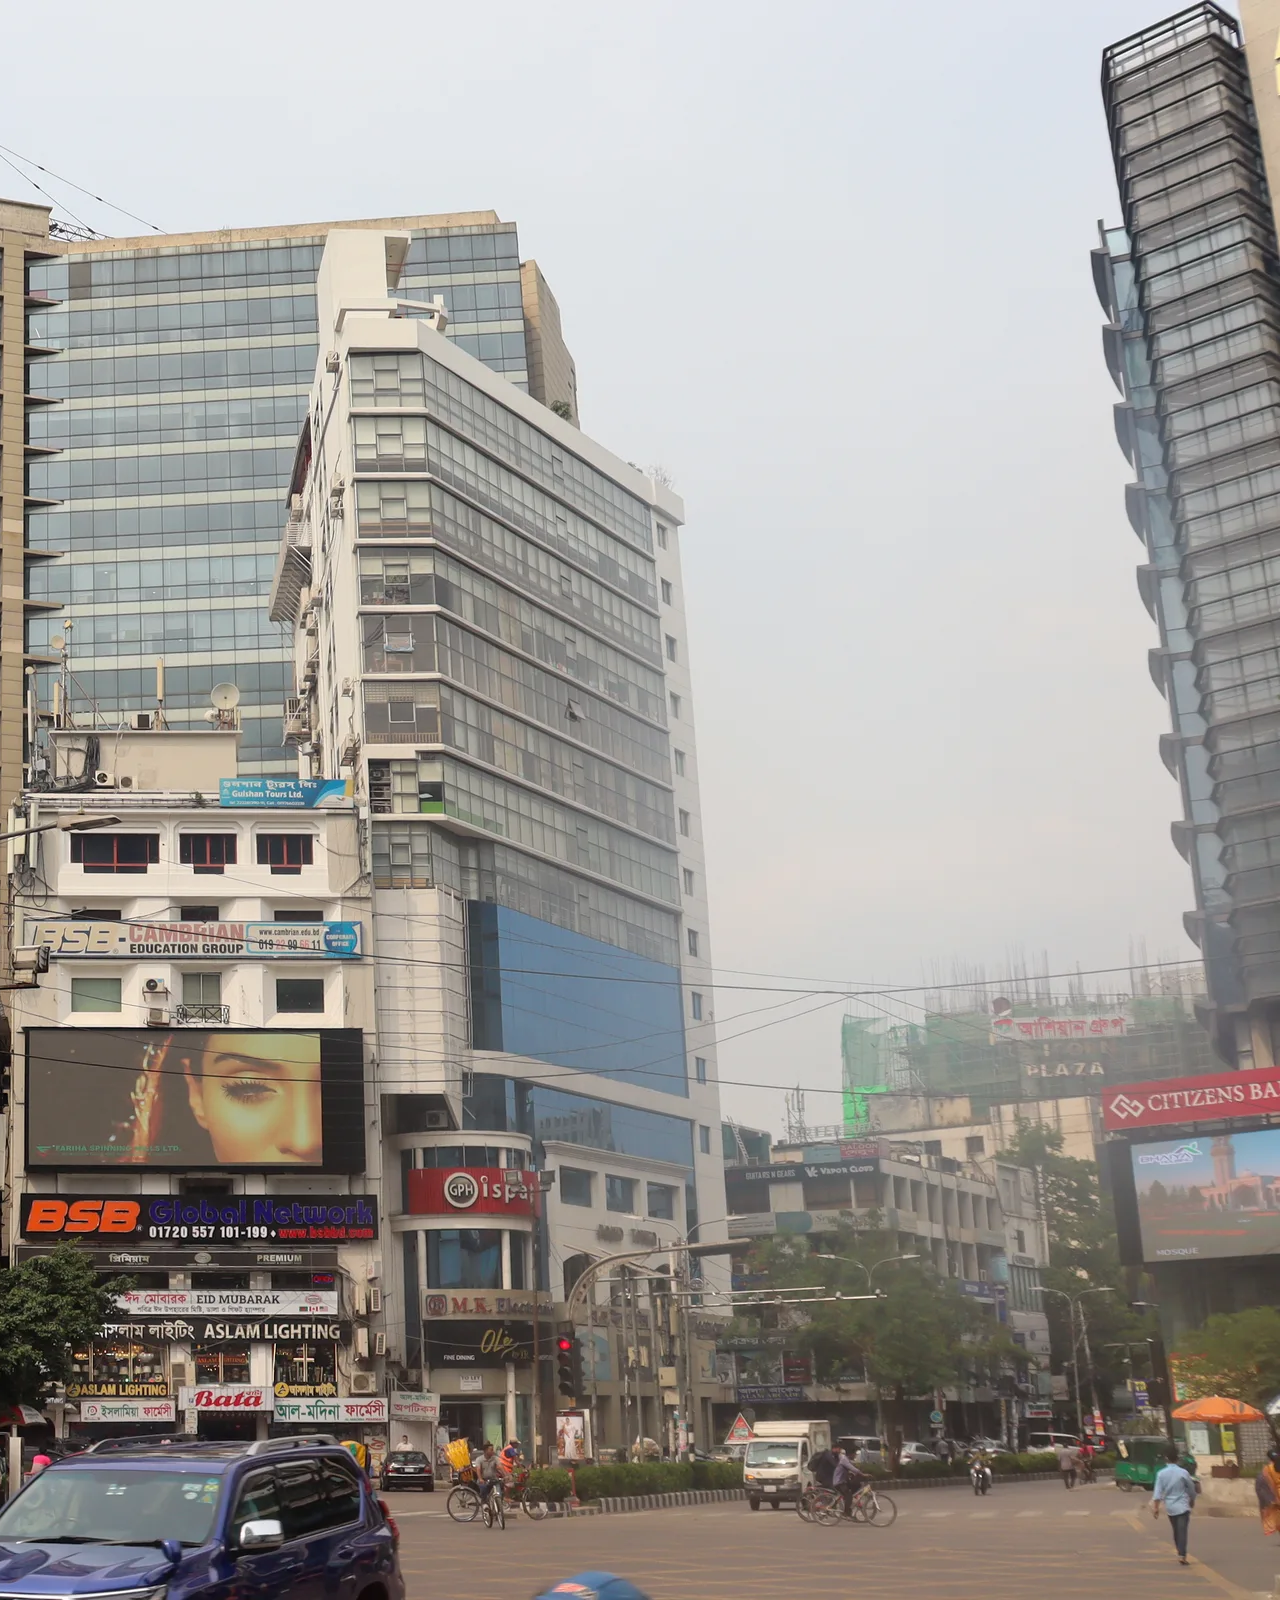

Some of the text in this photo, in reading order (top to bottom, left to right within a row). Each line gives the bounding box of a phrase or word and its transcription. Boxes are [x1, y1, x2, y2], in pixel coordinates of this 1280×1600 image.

[232, 790, 304, 798] Gulshan Tours Ltd.
[128, 923, 244, 943] CAMBRIAN
[258, 928, 320, 936] www.cambrian.edu.bd
[130, 943, 244, 954] EDUCATION GROUP
[1026, 1061, 1105, 1077] PLAZA
[1148, 1080, 1280, 1111] CITIZENS BA
[776, 1169, 796, 1178] GEARS
[449, 1183, 474, 1197] GPH
[26, 1199, 374, 1233] BSB Global Network
[149, 1226, 374, 1239] 01720 557 101-199 www.bsbbd.com
[256, 1254, 302, 1262] PREMIUM
[1156, 1247, 1199, 1256] MOSQUE
[124, 1291, 187, 1305] ঈদ মোবারক
[196, 1294, 280, 1304] EID MUBARAK
[451, 1296, 493, 1314] M.K.
[148, 1320, 195, 1340] লাইটিং
[204, 1323, 341, 1339] ASLAM LIGHTING
[81, 1384, 167, 1396] ASLAM LIGHTING
[194, 1390, 264, 1408] Bata
[101, 1403, 172, 1418] ইসলামিয়া ফার্মেসী
[275, 1399, 386, 1421] আল-মদিনা ফার্মেসী
